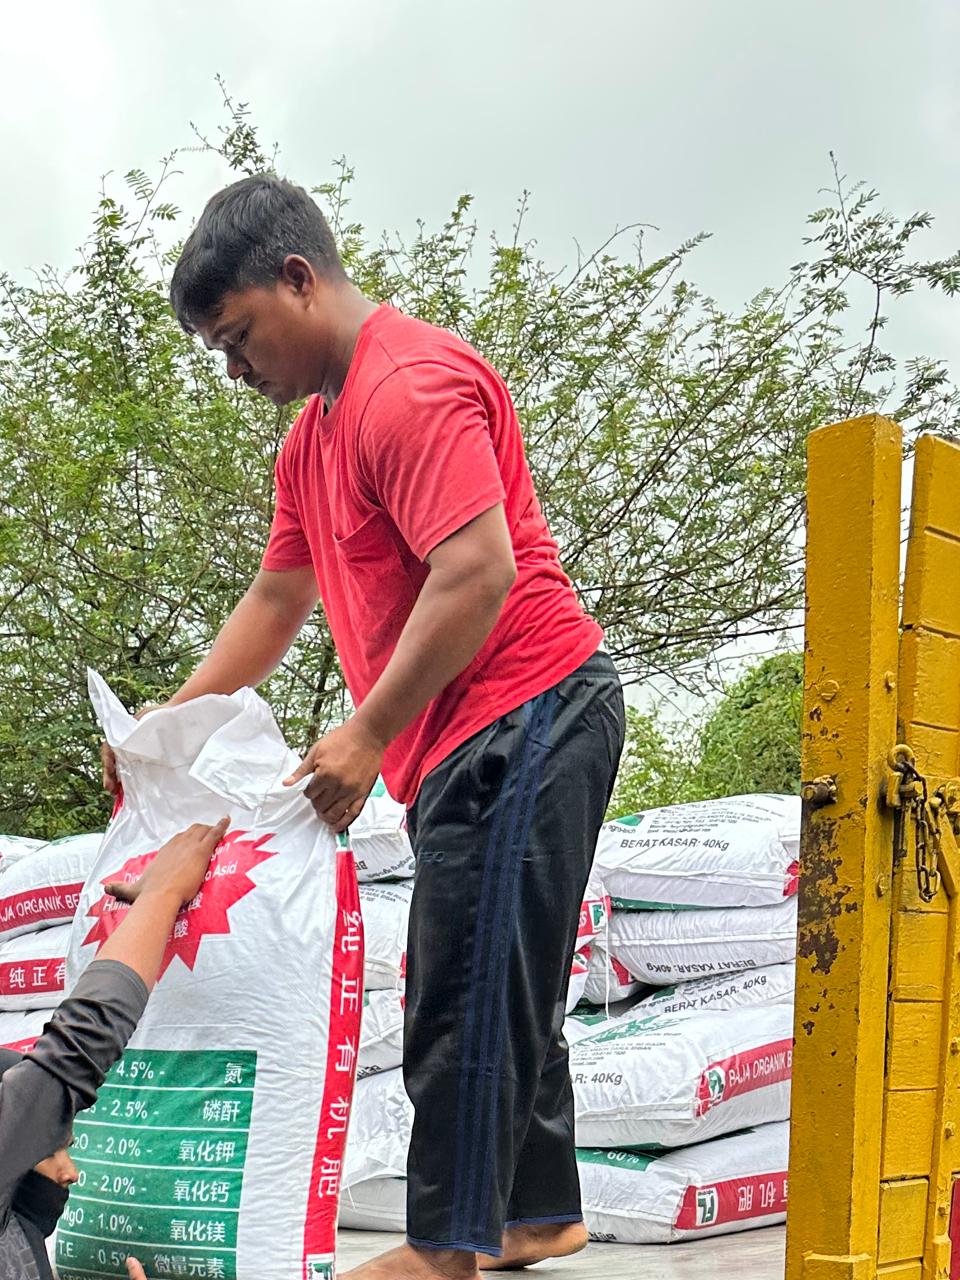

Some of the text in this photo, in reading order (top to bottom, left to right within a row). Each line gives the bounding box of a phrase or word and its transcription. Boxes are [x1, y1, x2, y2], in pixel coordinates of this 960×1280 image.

[620, 837, 729, 851] BERAT KASAR: 40Kg
[212, 861, 238, 877] Asid
[18, 893, 62, 918] ORGANIK
[647, 962, 672, 973] 40Kg
[673, 962, 716, 973] KASAR:
[664, 999, 698, 1013] BERAT
[700, 986, 739, 1006] KASAR:
[742, 975, 767, 991] 40Kg
[116, 1061, 154, 1079] 4.5%
[224, 1062, 243, 1084] 氮
[752, 1053, 786, 1078] ORGANIK
[591, 1072, 623, 1086] 40Kg
[110, 1100, 148, 1119] 2.5%
[72, 1133, 88, 1150] 2O
[105, 1136, 141, 1157] 2.0%
[179, 1140, 235, 1162] 氧化钾
[608, 1151, 640, 1164] 60%
[100, 1175, 136, 1195] 2.0%
[174, 1179, 231, 1203] 氧化钙
[697, 1194, 715, 1223] FL
[61, 1207, 84, 1227] MgO
[98, 1213, 133, 1234] 1.0%
[170, 1219, 225, 1243] 氧化镁
[58, 1239, 77, 1258] T.E.
[153, 1253, 225, 1279] 微量元素
